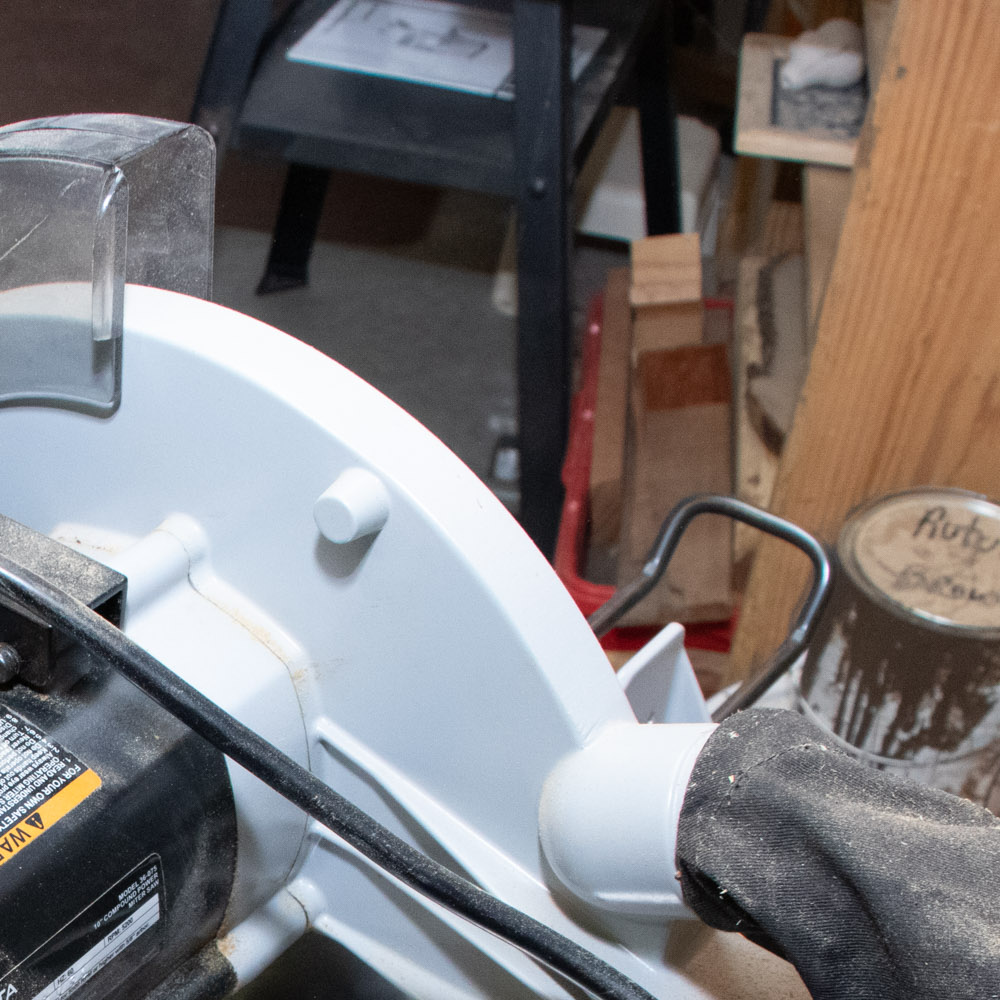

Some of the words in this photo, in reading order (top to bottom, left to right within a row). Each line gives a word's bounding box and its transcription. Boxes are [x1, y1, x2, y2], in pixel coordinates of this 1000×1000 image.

[22, 755, 59, 785] OPERATING
[43, 761, 65, 779] READ
[62, 763, 81, 779] FOR
[3, 782, 25, 800] MITER
[42, 775, 65, 795] YOUR
[23, 791, 45, 809] OWN
[103, 888, 136, 922] COMPOUND
[137, 870, 158, 894] POWER
[117, 878, 138, 902] MODEL
[128, 889, 145, 909] MITER
